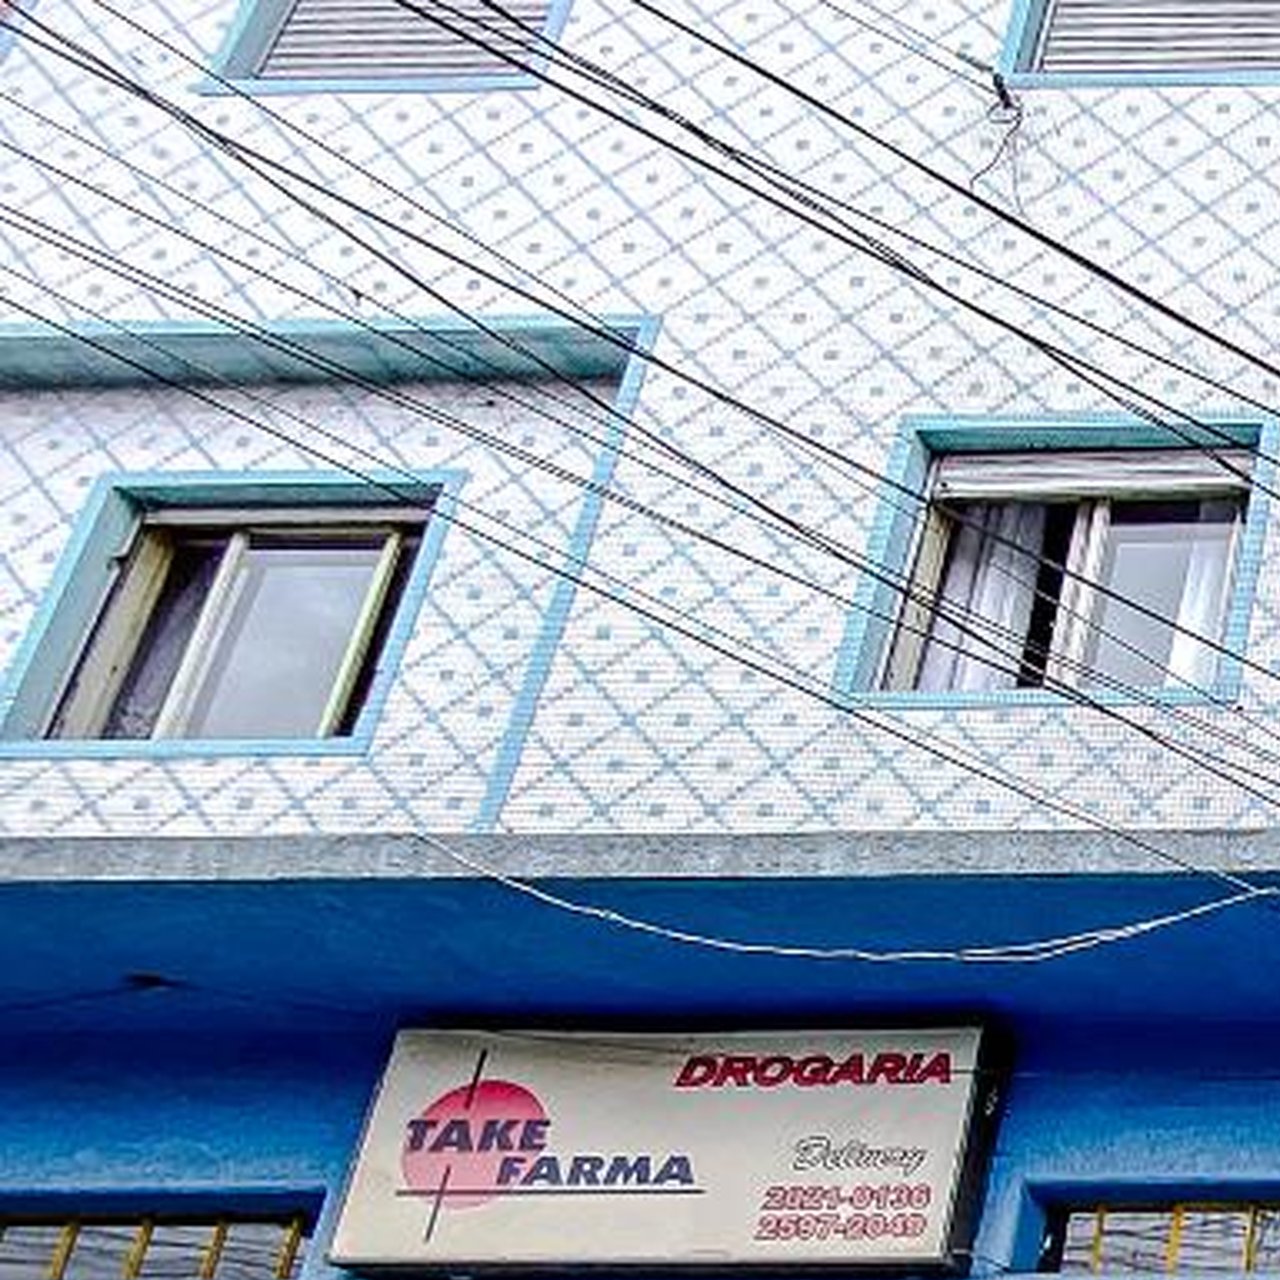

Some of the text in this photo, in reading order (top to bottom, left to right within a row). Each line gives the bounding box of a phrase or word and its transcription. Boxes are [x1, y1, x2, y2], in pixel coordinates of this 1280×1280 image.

[674, 1053, 952, 1088] DROGARIA
[407, 1119, 551, 1152] TAKE
[496, 1155, 694, 1187] FARMA
